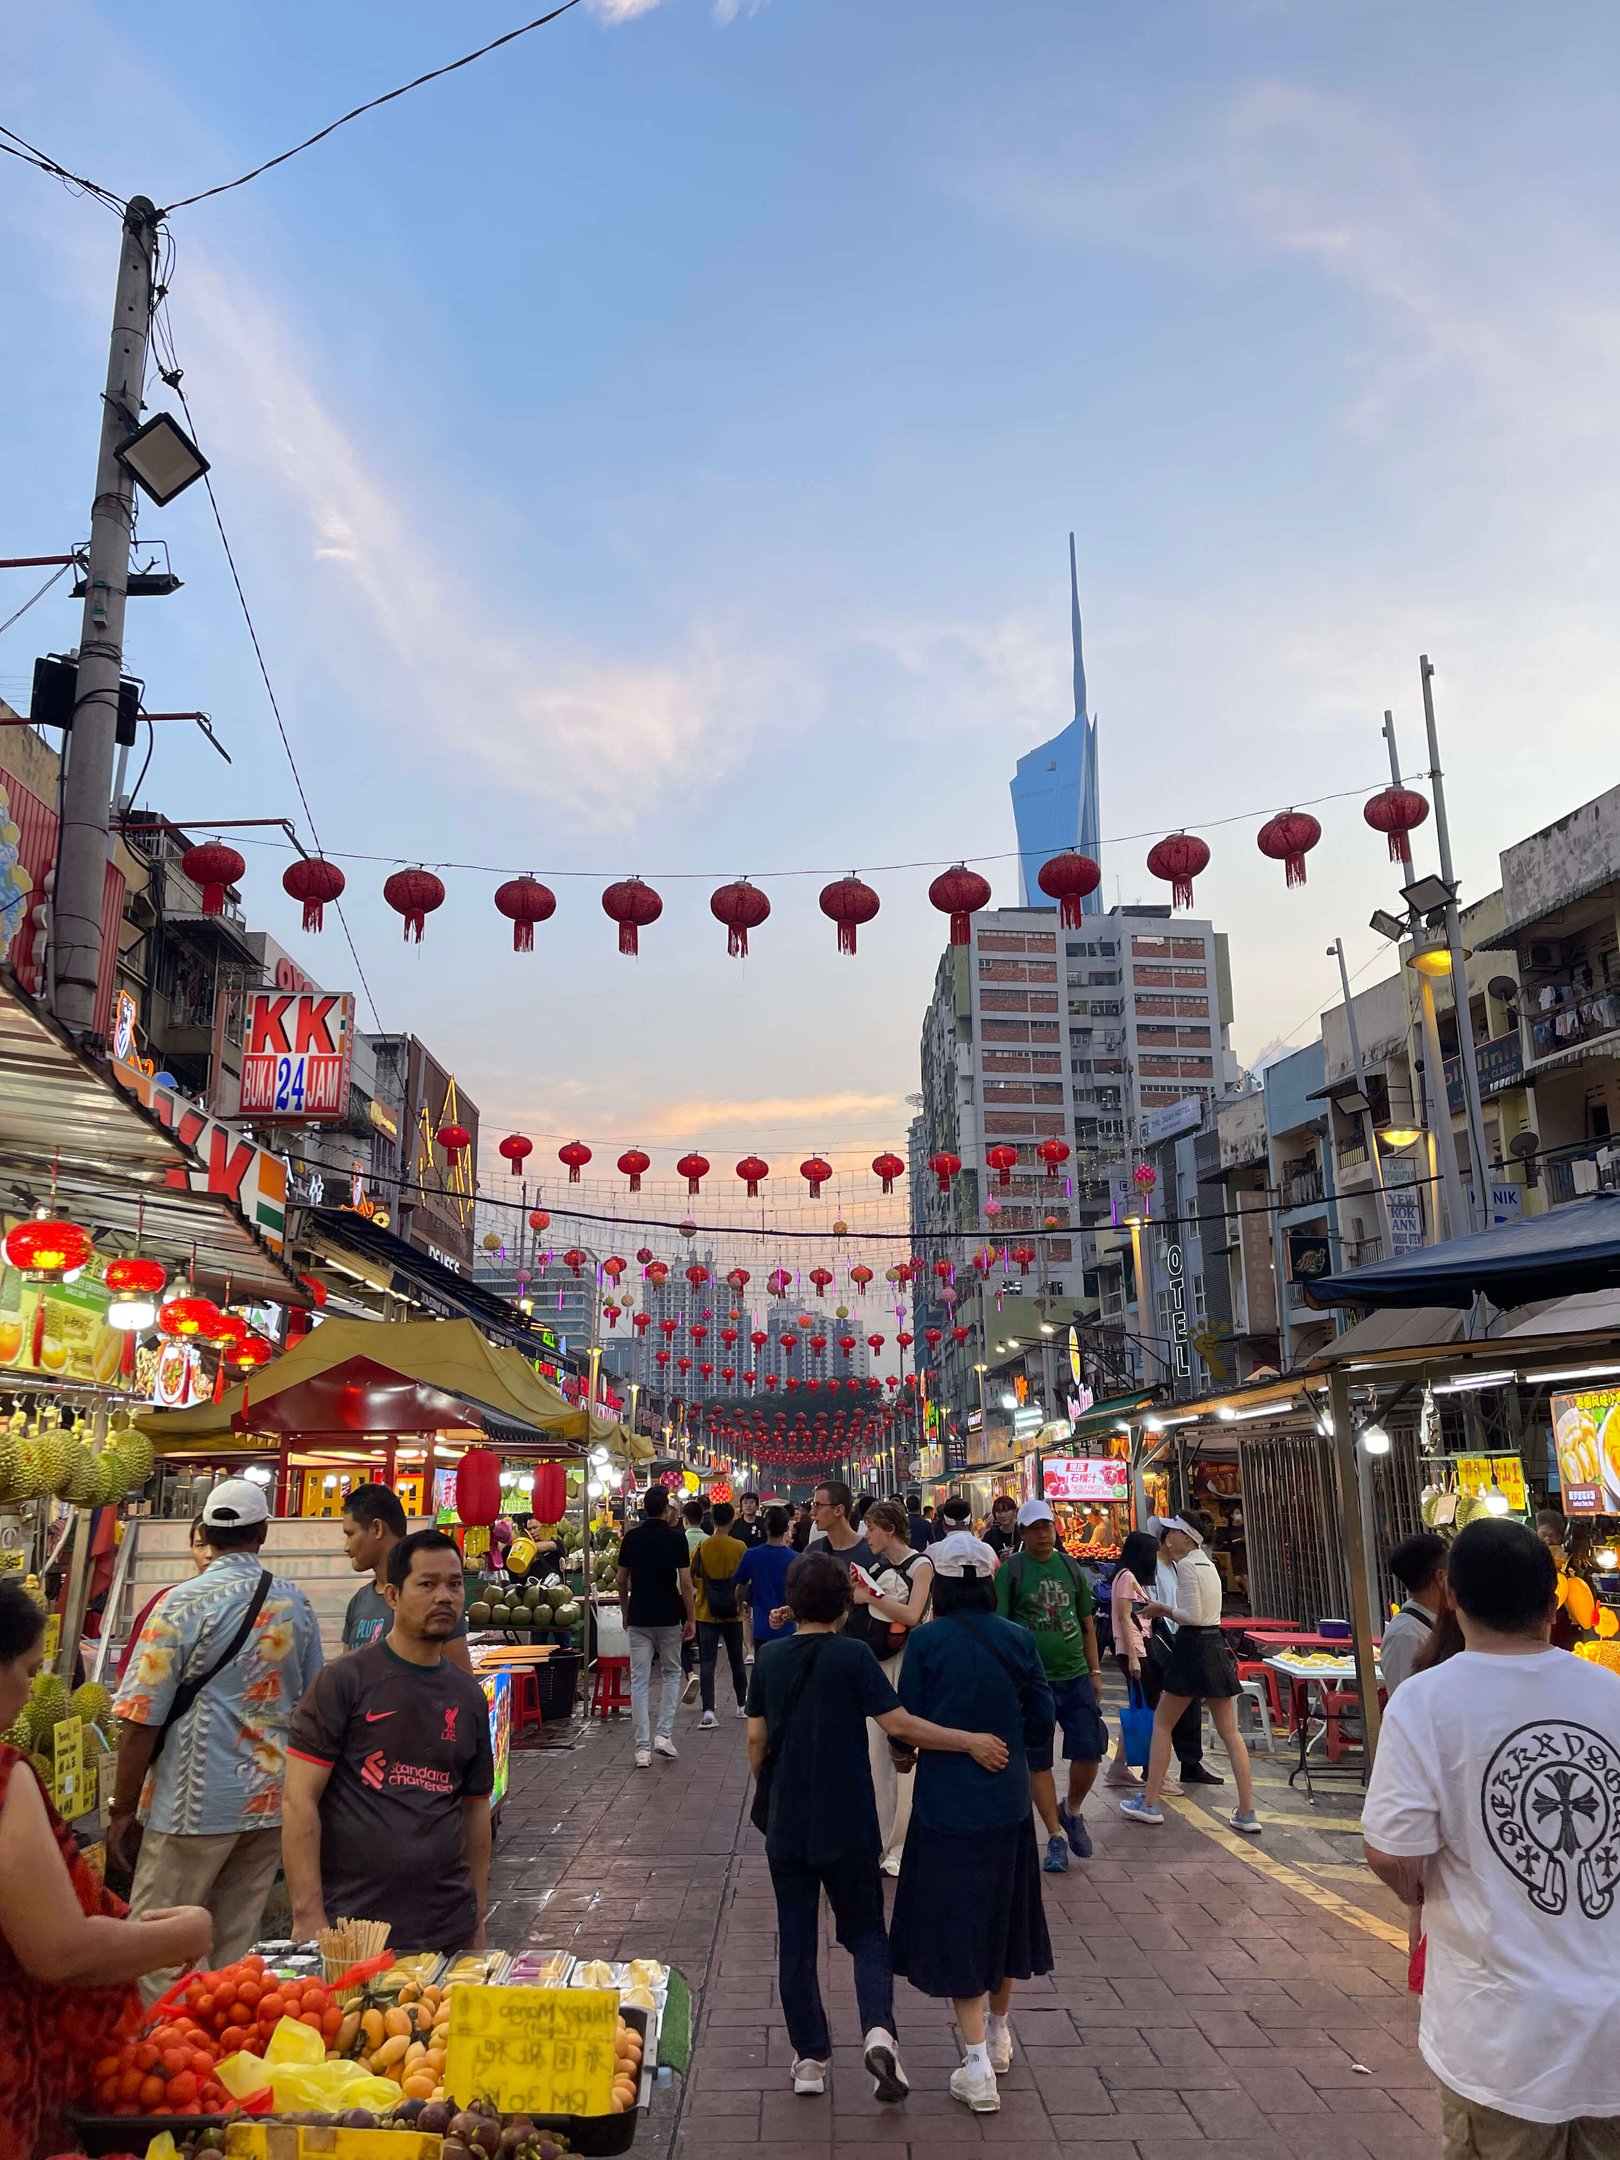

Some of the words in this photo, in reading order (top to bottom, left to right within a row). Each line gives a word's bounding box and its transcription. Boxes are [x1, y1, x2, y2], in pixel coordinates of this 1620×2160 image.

[251, 995, 341, 1054] KK
[242, 1060, 274, 1107] BUKA
[275, 1057, 305, 1112] 24
[307, 1061, 340, 1107] JAM
[1174, 1105, 1191, 1117] HOTEL
[1388, 1194, 1416, 1206] YEW
[1390, 1207, 1416, 1219] KOK
[1392, 1219, 1417, 1232] ANN
[390, 1760, 451, 1784] standard
[388, 1774, 454, 1794] chartered
